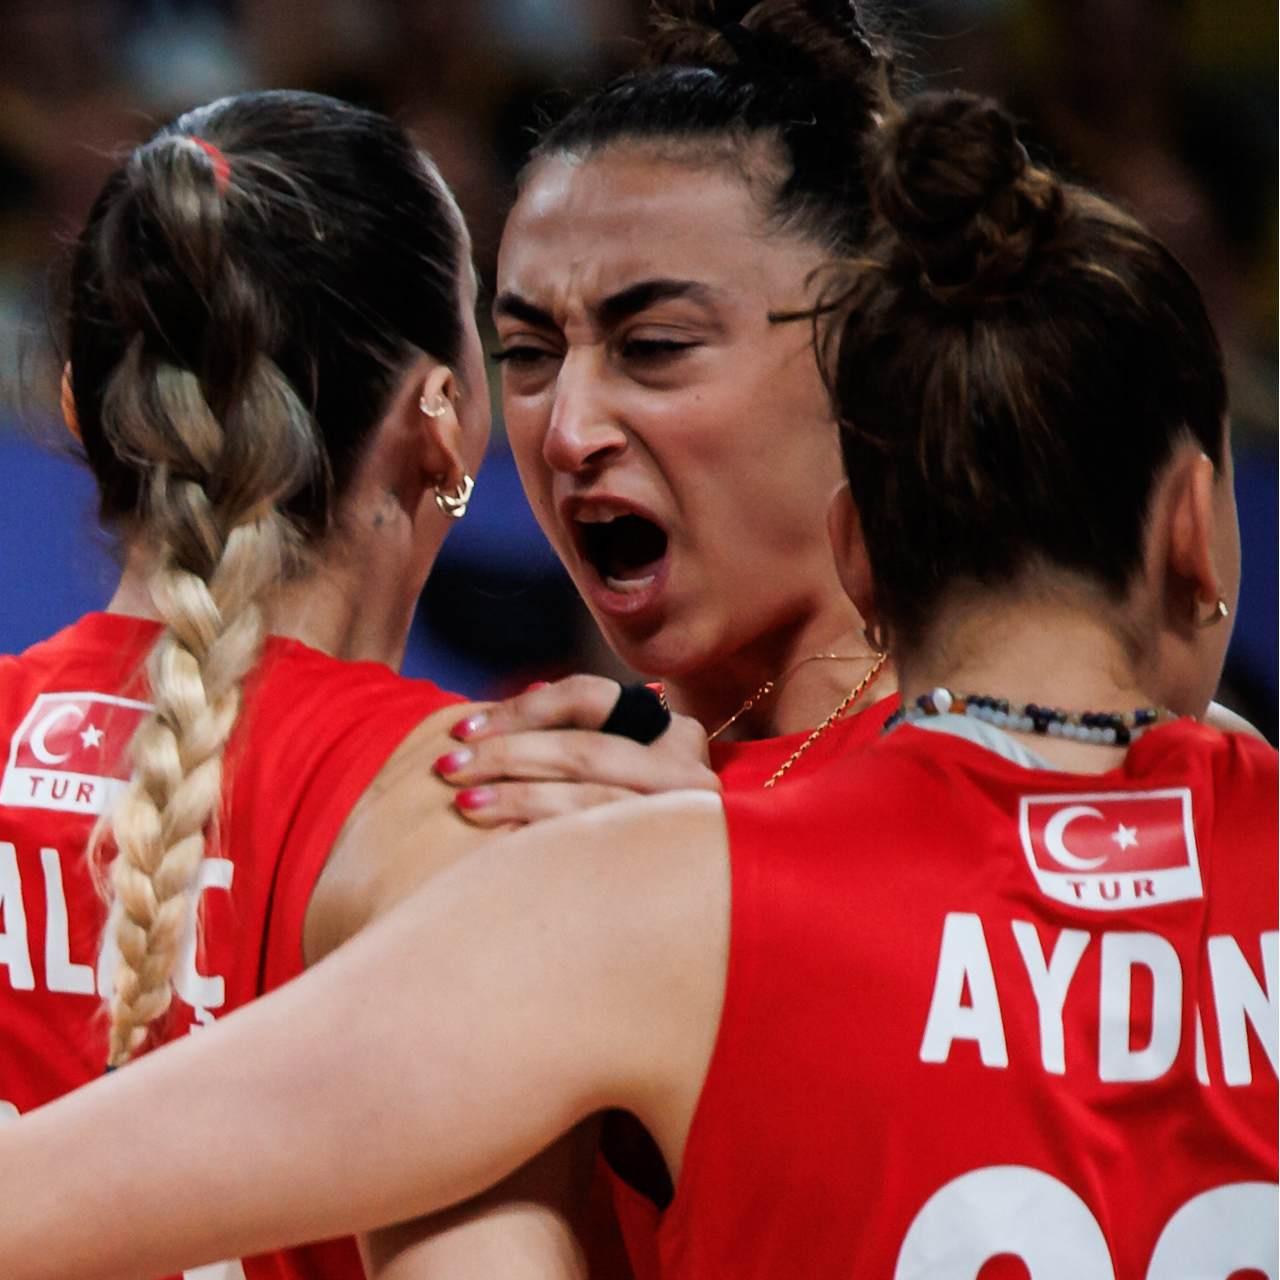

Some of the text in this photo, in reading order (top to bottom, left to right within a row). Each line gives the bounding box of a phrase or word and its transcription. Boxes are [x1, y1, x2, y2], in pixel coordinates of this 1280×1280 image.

[30, 776, 94, 803] TUR
[1066, 879, 1156, 901] TUR
[920, 912, 1278, 1087] AYDN
